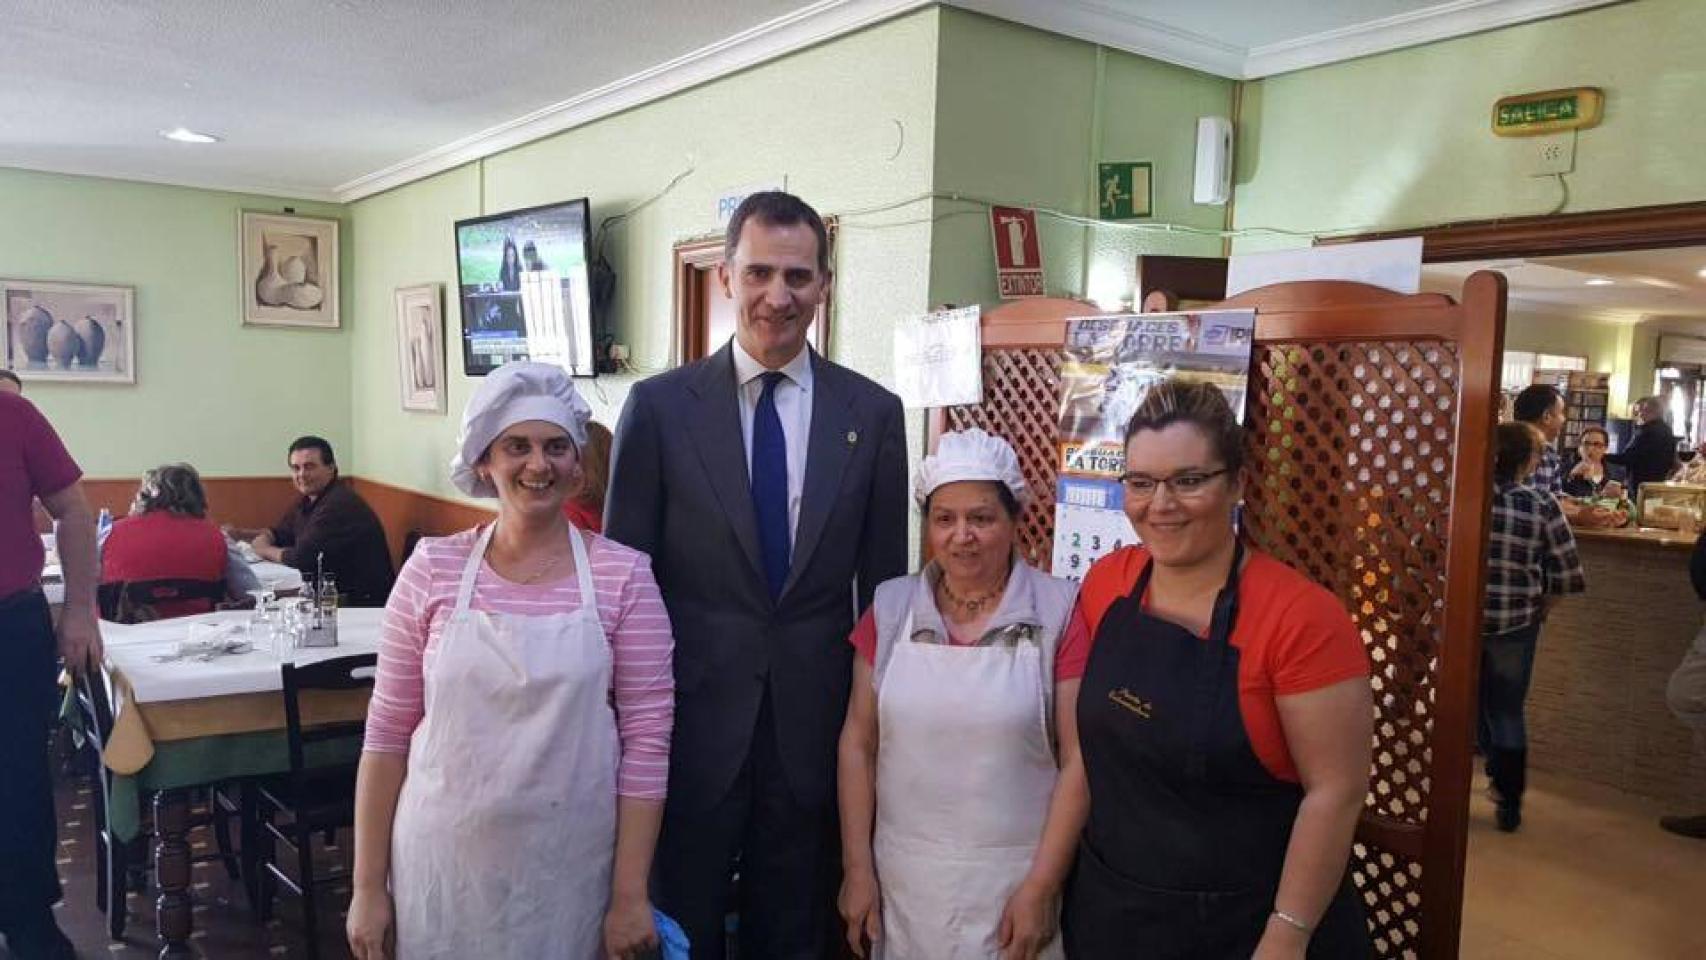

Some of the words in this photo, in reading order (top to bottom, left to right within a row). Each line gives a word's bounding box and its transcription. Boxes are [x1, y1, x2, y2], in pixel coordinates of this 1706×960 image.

[1072, 532, 1081, 547] 2
[1092, 534, 1101, 550] 3
[1071, 554, 1080, 568] 9
